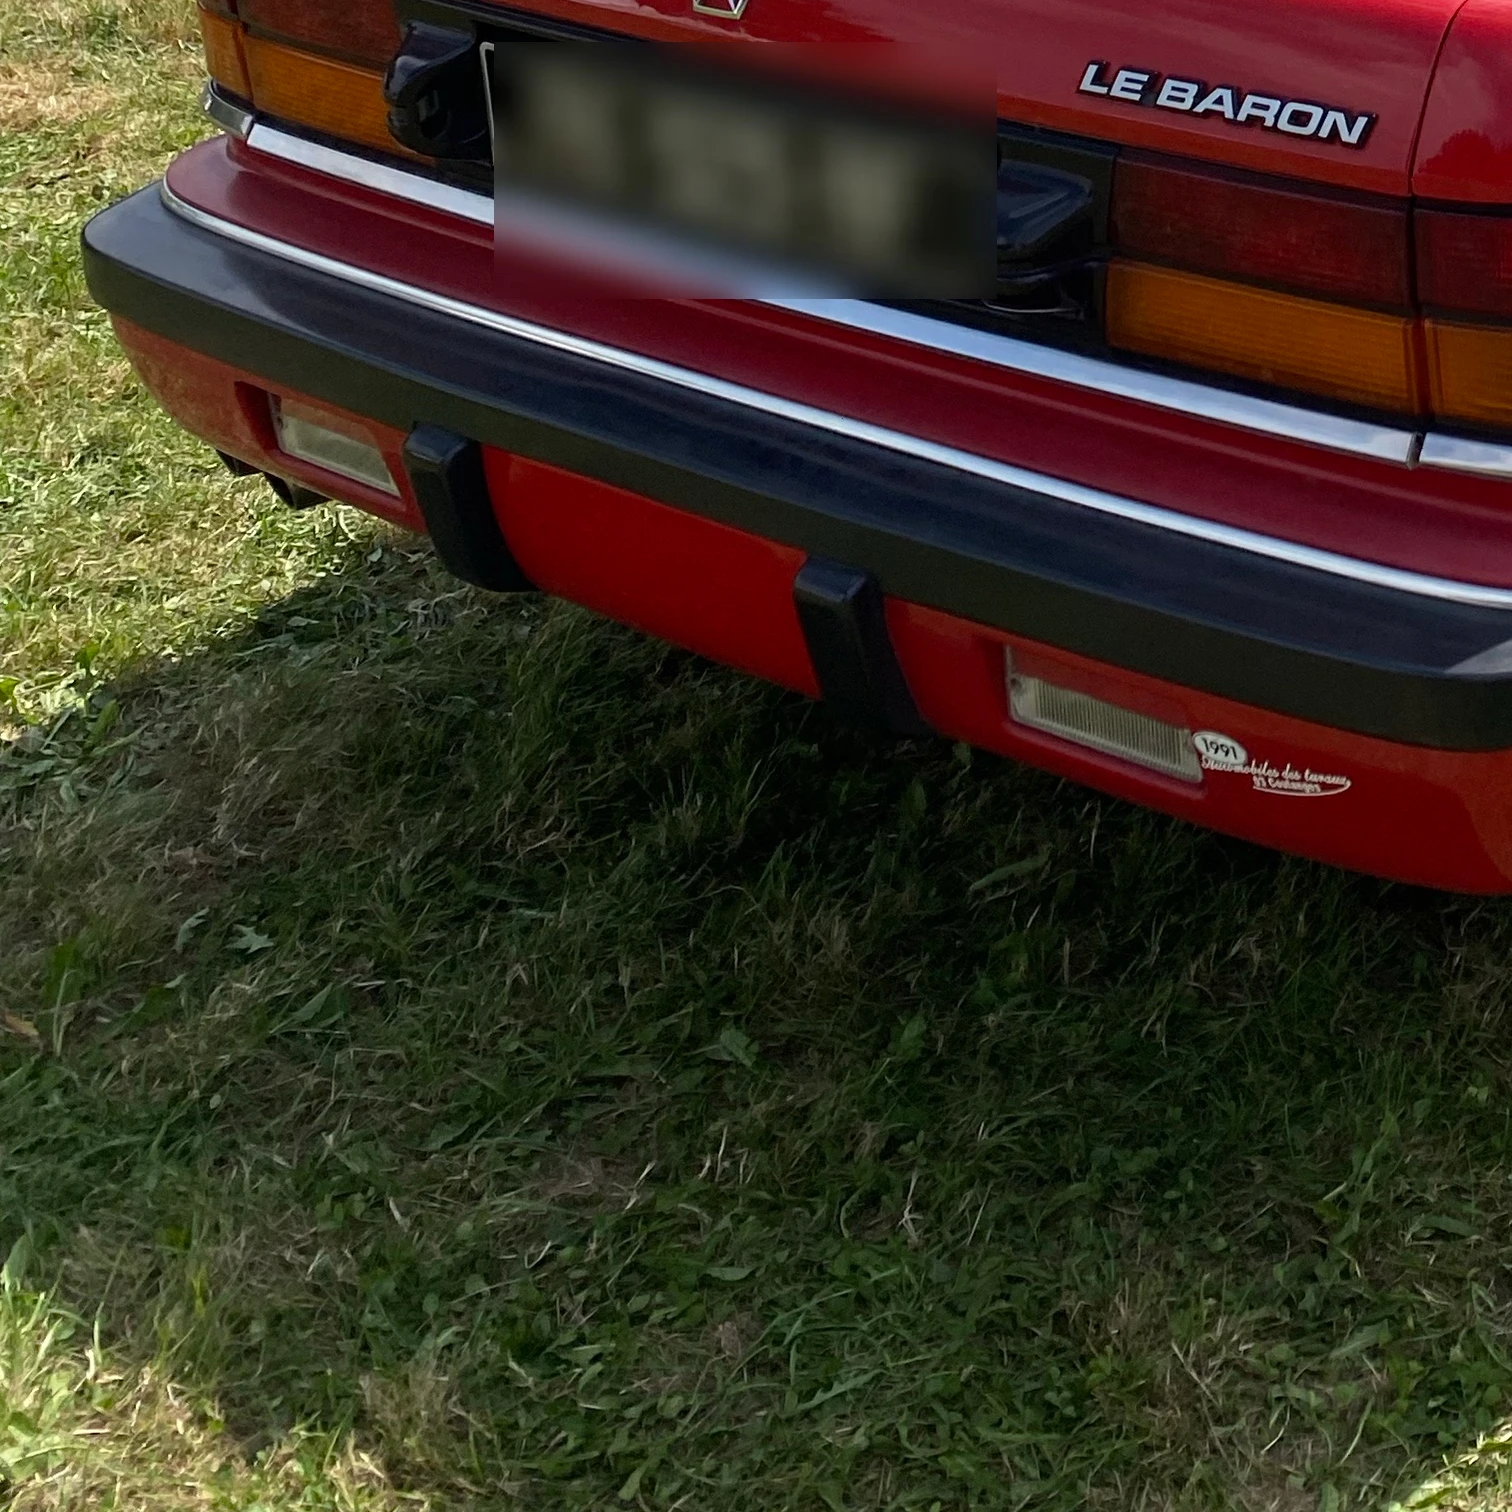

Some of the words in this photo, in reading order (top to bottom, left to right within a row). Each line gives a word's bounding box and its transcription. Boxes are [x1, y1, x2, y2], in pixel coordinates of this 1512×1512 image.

[1078, 63, 1150, 102] LE
[1154, 77, 1369, 145] BARON
[1202, 738, 1239, 761] 1991
[1281, 763, 1302, 781] des
